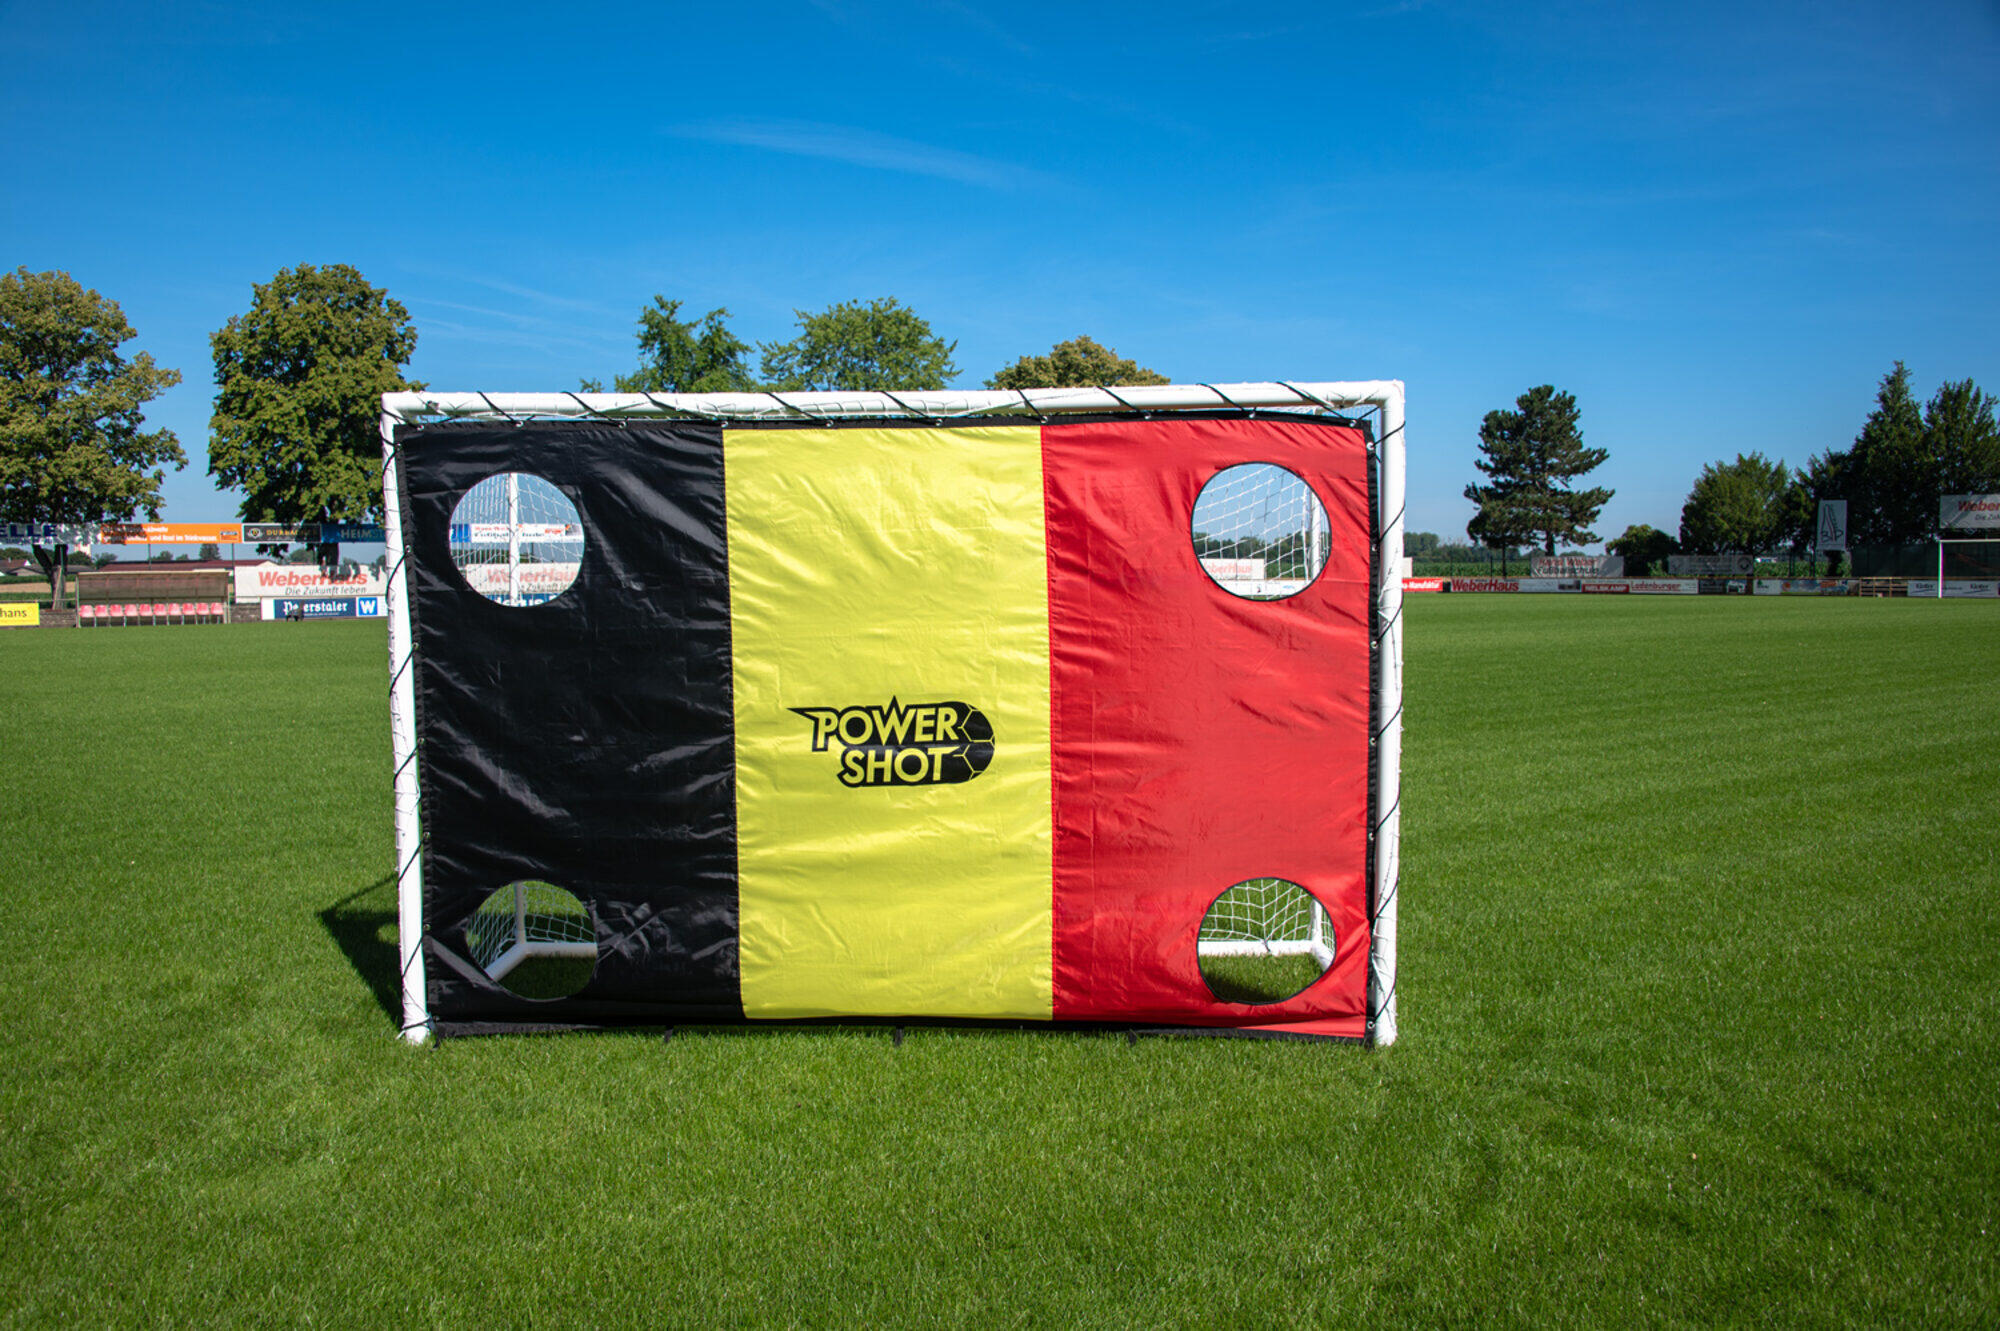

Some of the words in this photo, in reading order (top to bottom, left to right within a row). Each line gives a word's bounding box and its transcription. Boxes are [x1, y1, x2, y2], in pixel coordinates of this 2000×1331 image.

[284, 587, 298, 595] Die
[303, 586, 338, 596] Zukunft
[340, 586, 367, 595] leben
[1451, 579, 1519, 592] WeberHaus
[283, 601, 348, 614] Peerstaler
[359, 600, 376, 614] W
[799, 700, 961, 751] POWER
[839, 746, 962, 786] SHOT
